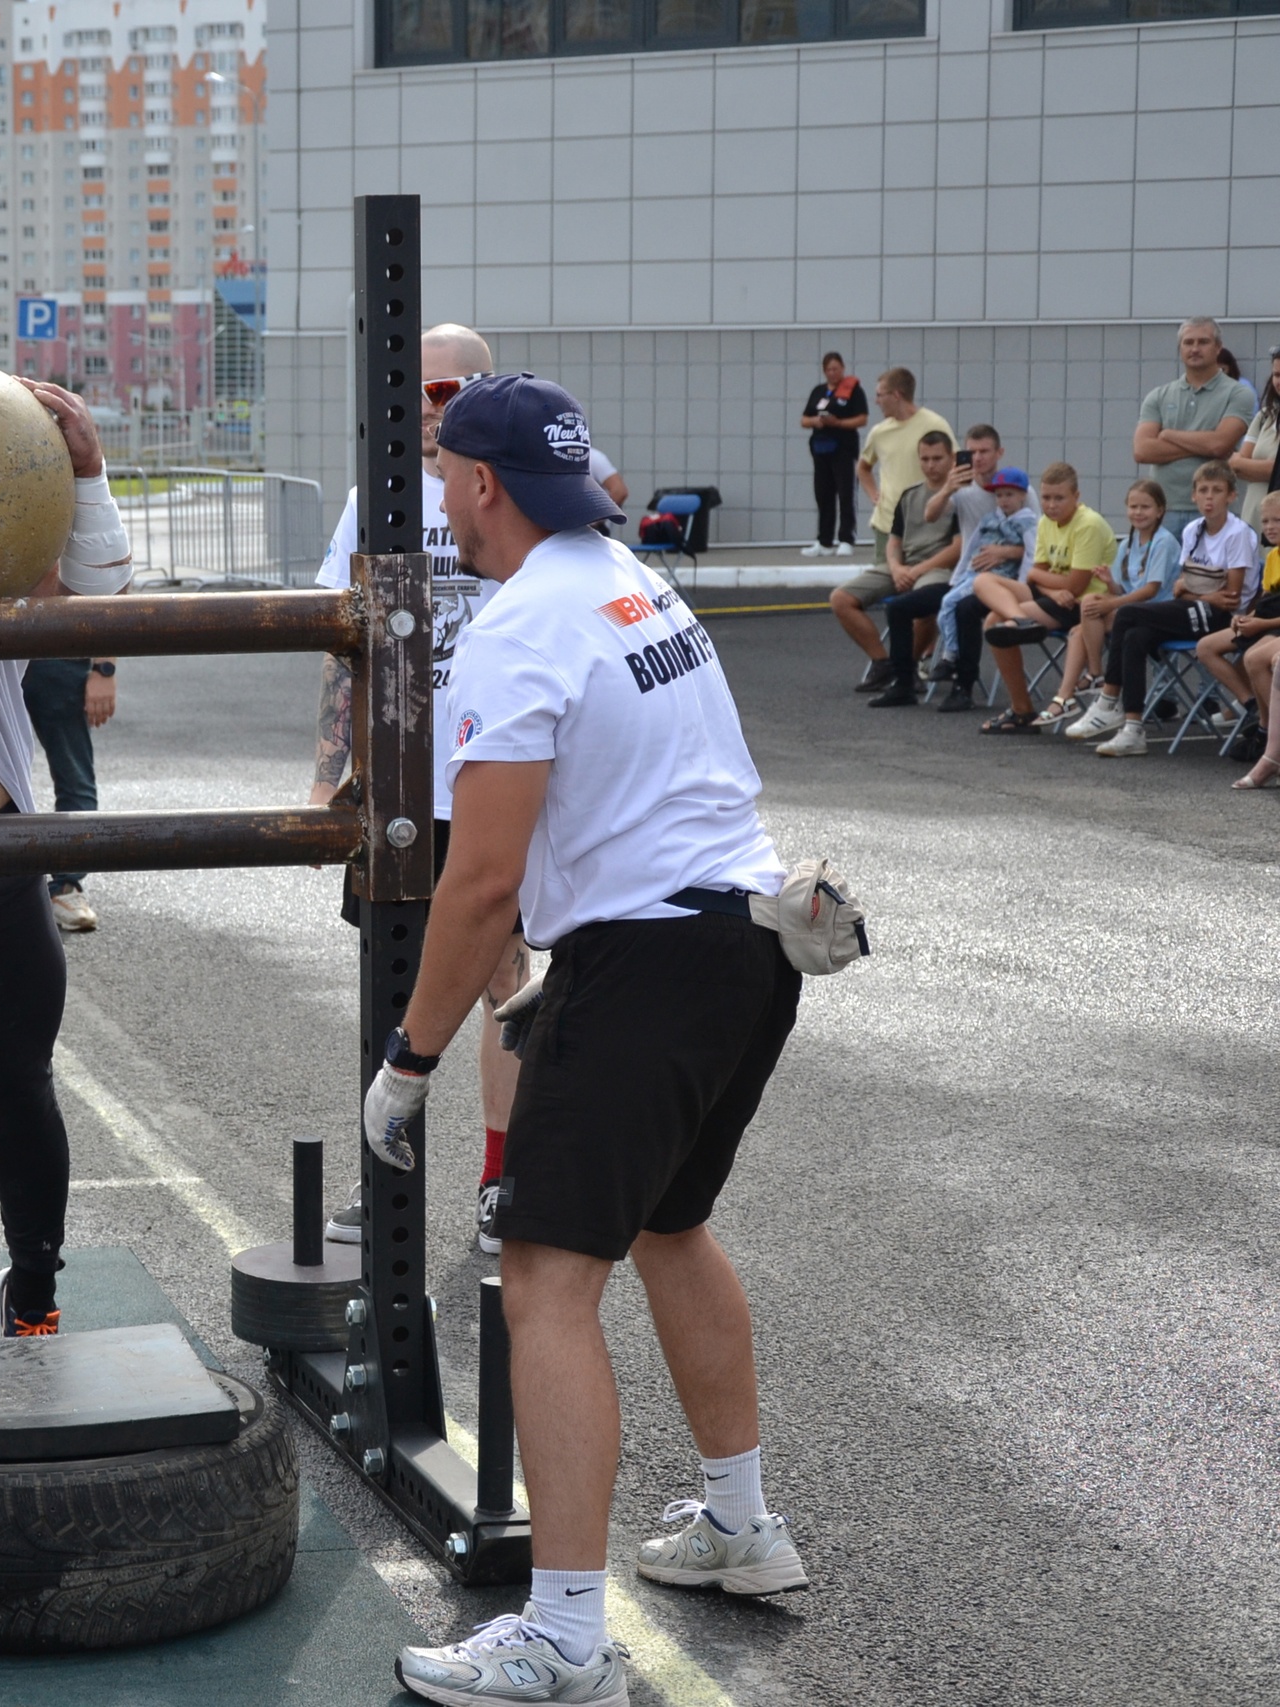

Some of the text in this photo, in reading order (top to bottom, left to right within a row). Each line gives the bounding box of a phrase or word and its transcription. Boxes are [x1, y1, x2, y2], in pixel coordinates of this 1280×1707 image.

[27, 302, 51, 336] P
[543, 424, 577, 441] New
[592, 591, 656, 629] BN
[689, 1531, 711, 1557] N
[500, 1658, 540, 1687] N
